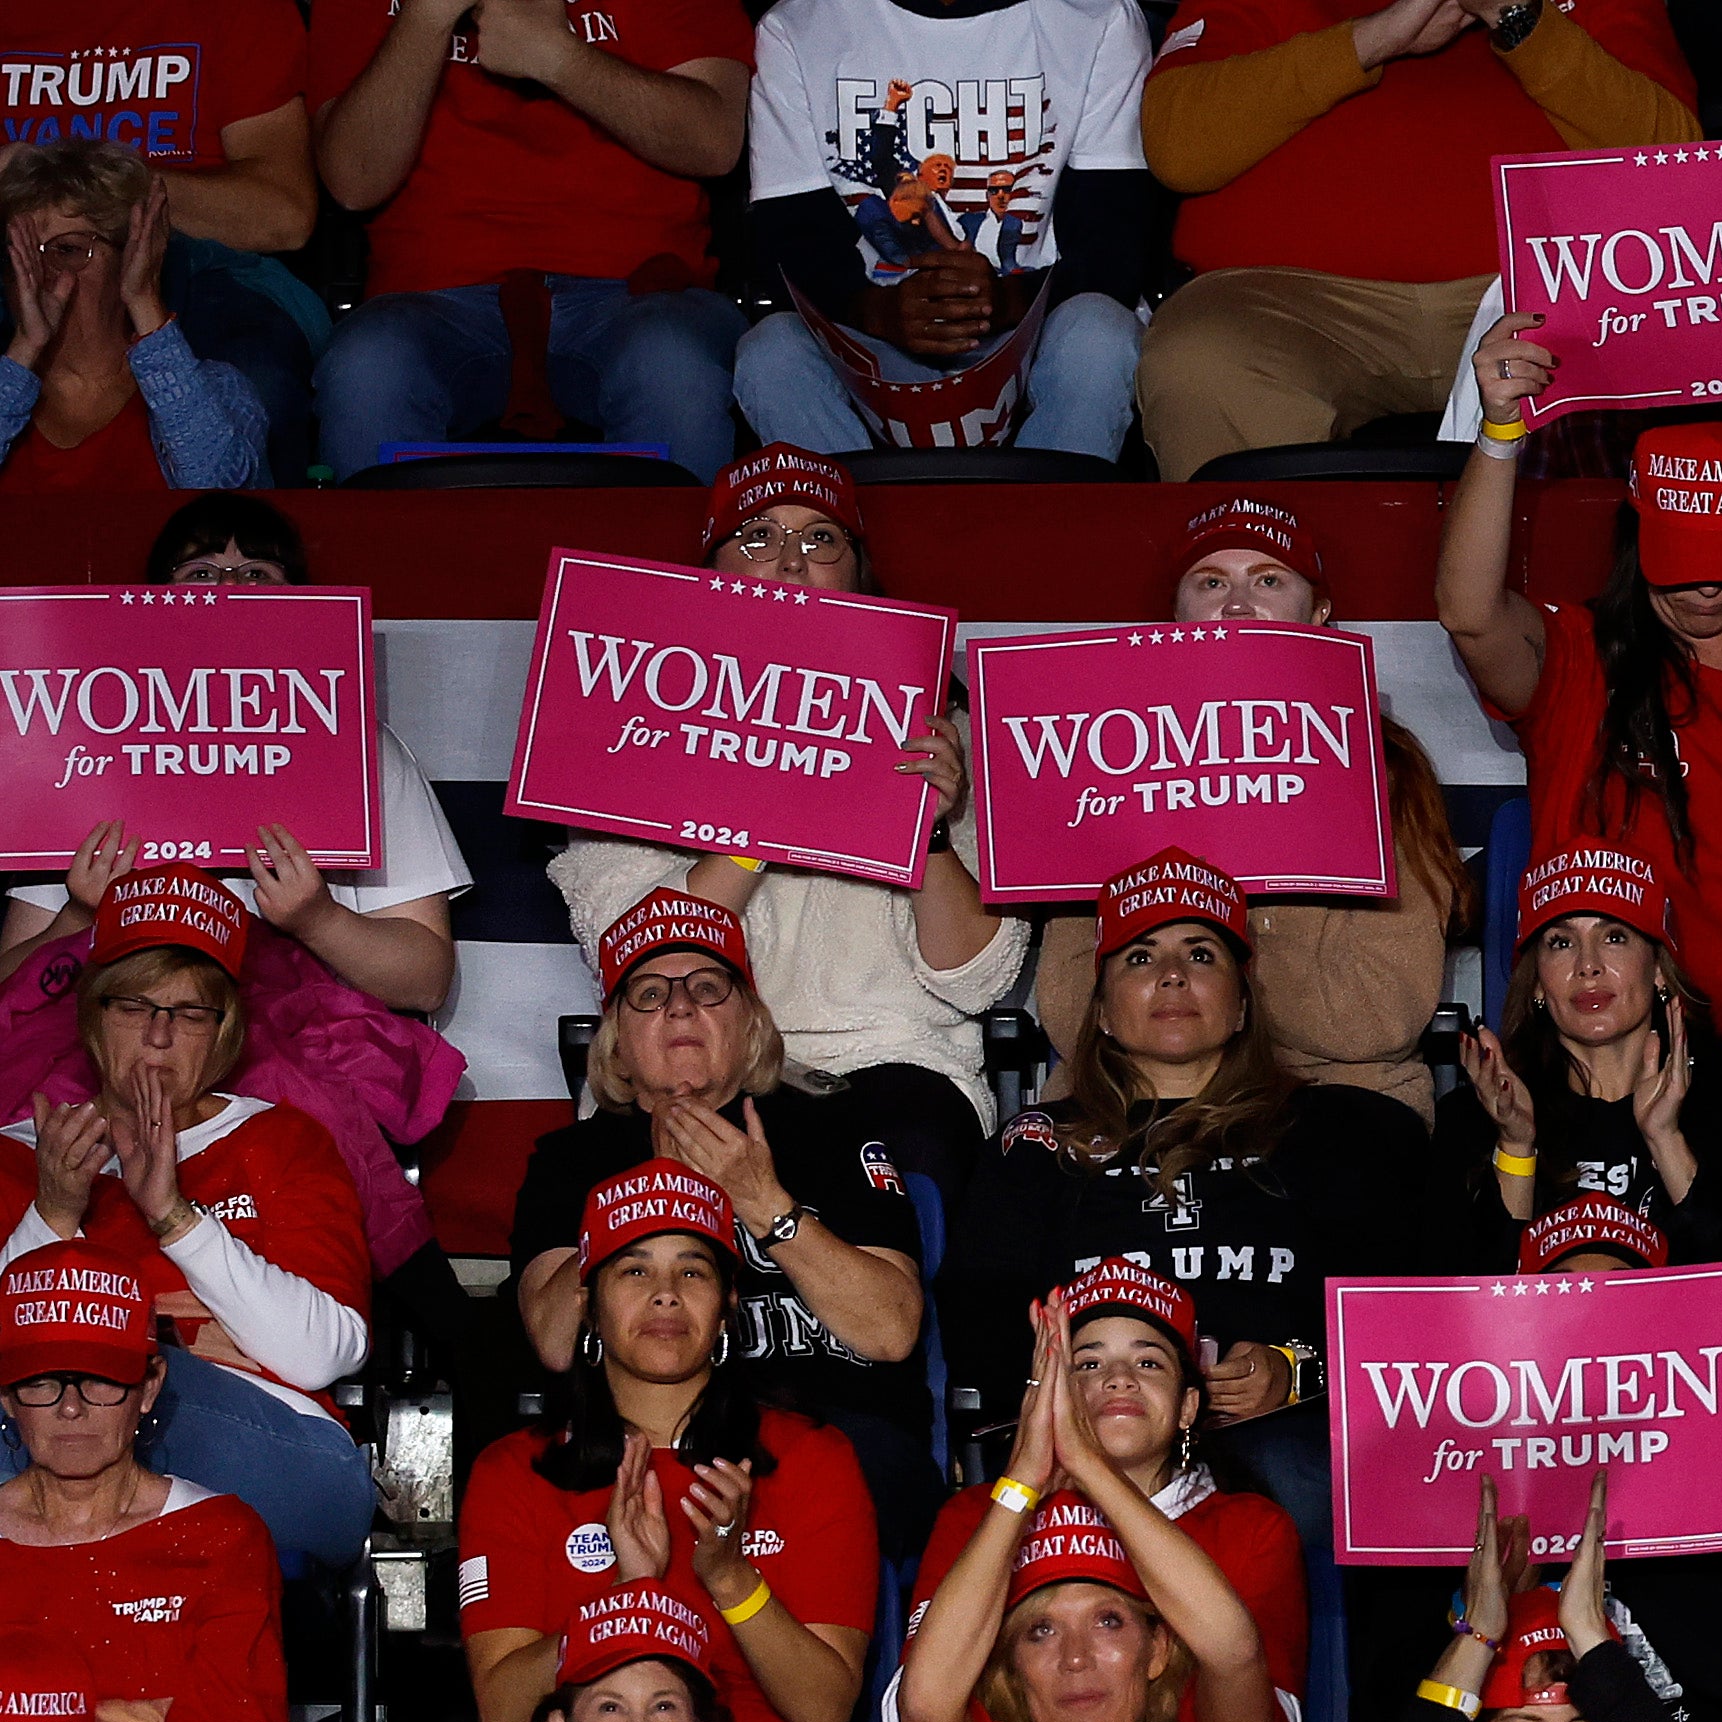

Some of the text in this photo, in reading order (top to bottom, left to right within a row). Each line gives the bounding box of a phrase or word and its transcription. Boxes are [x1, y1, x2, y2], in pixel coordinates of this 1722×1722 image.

[2, 56, 191, 107] TRUMP
[1593, 307, 1646, 346] for
[1648, 454, 1697, 482] MAKE
[1656, 487, 1713, 515] GREAT
[0, 668, 344, 735] WOMEN
[568, 630, 924, 749] WOMEN
[607, 716, 850, 778] for TRUMP
[1002, 701, 1354, 778] WOMEN
[55, 745, 290, 788] for TRUMP
[1068, 775, 1304, 827] for TRUMP
[144, 842, 211, 859] 2024
[680, 821, 748, 847] 2024
[6, 1267, 143, 1301] MAKE AMERICA
[13, 1300, 131, 1331] GREAT AGAIN
[1424, 1431, 1668, 1482] for TRUMP
